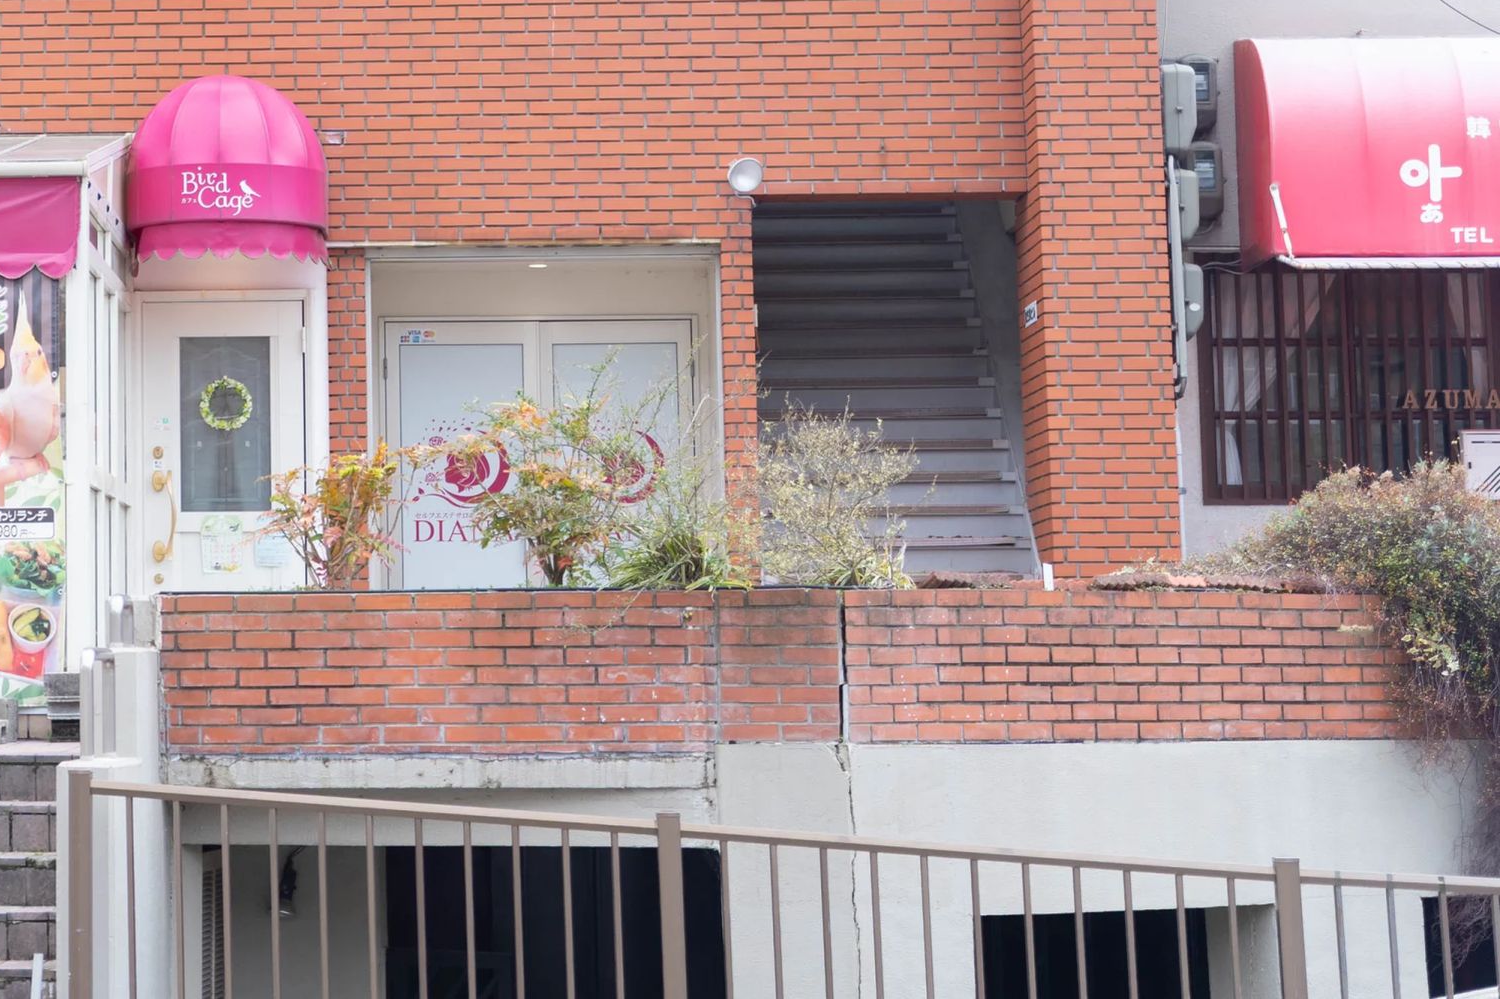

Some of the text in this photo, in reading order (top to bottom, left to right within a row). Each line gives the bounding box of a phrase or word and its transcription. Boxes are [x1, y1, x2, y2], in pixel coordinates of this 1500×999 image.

[181, 166, 231, 195] Bird
[197, 185, 254, 216] Cage
[1420, 203, 1444, 224] あ
[1450, 227, 1494, 244] TEL
[1402, 389, 1500, 409] AZUMA
